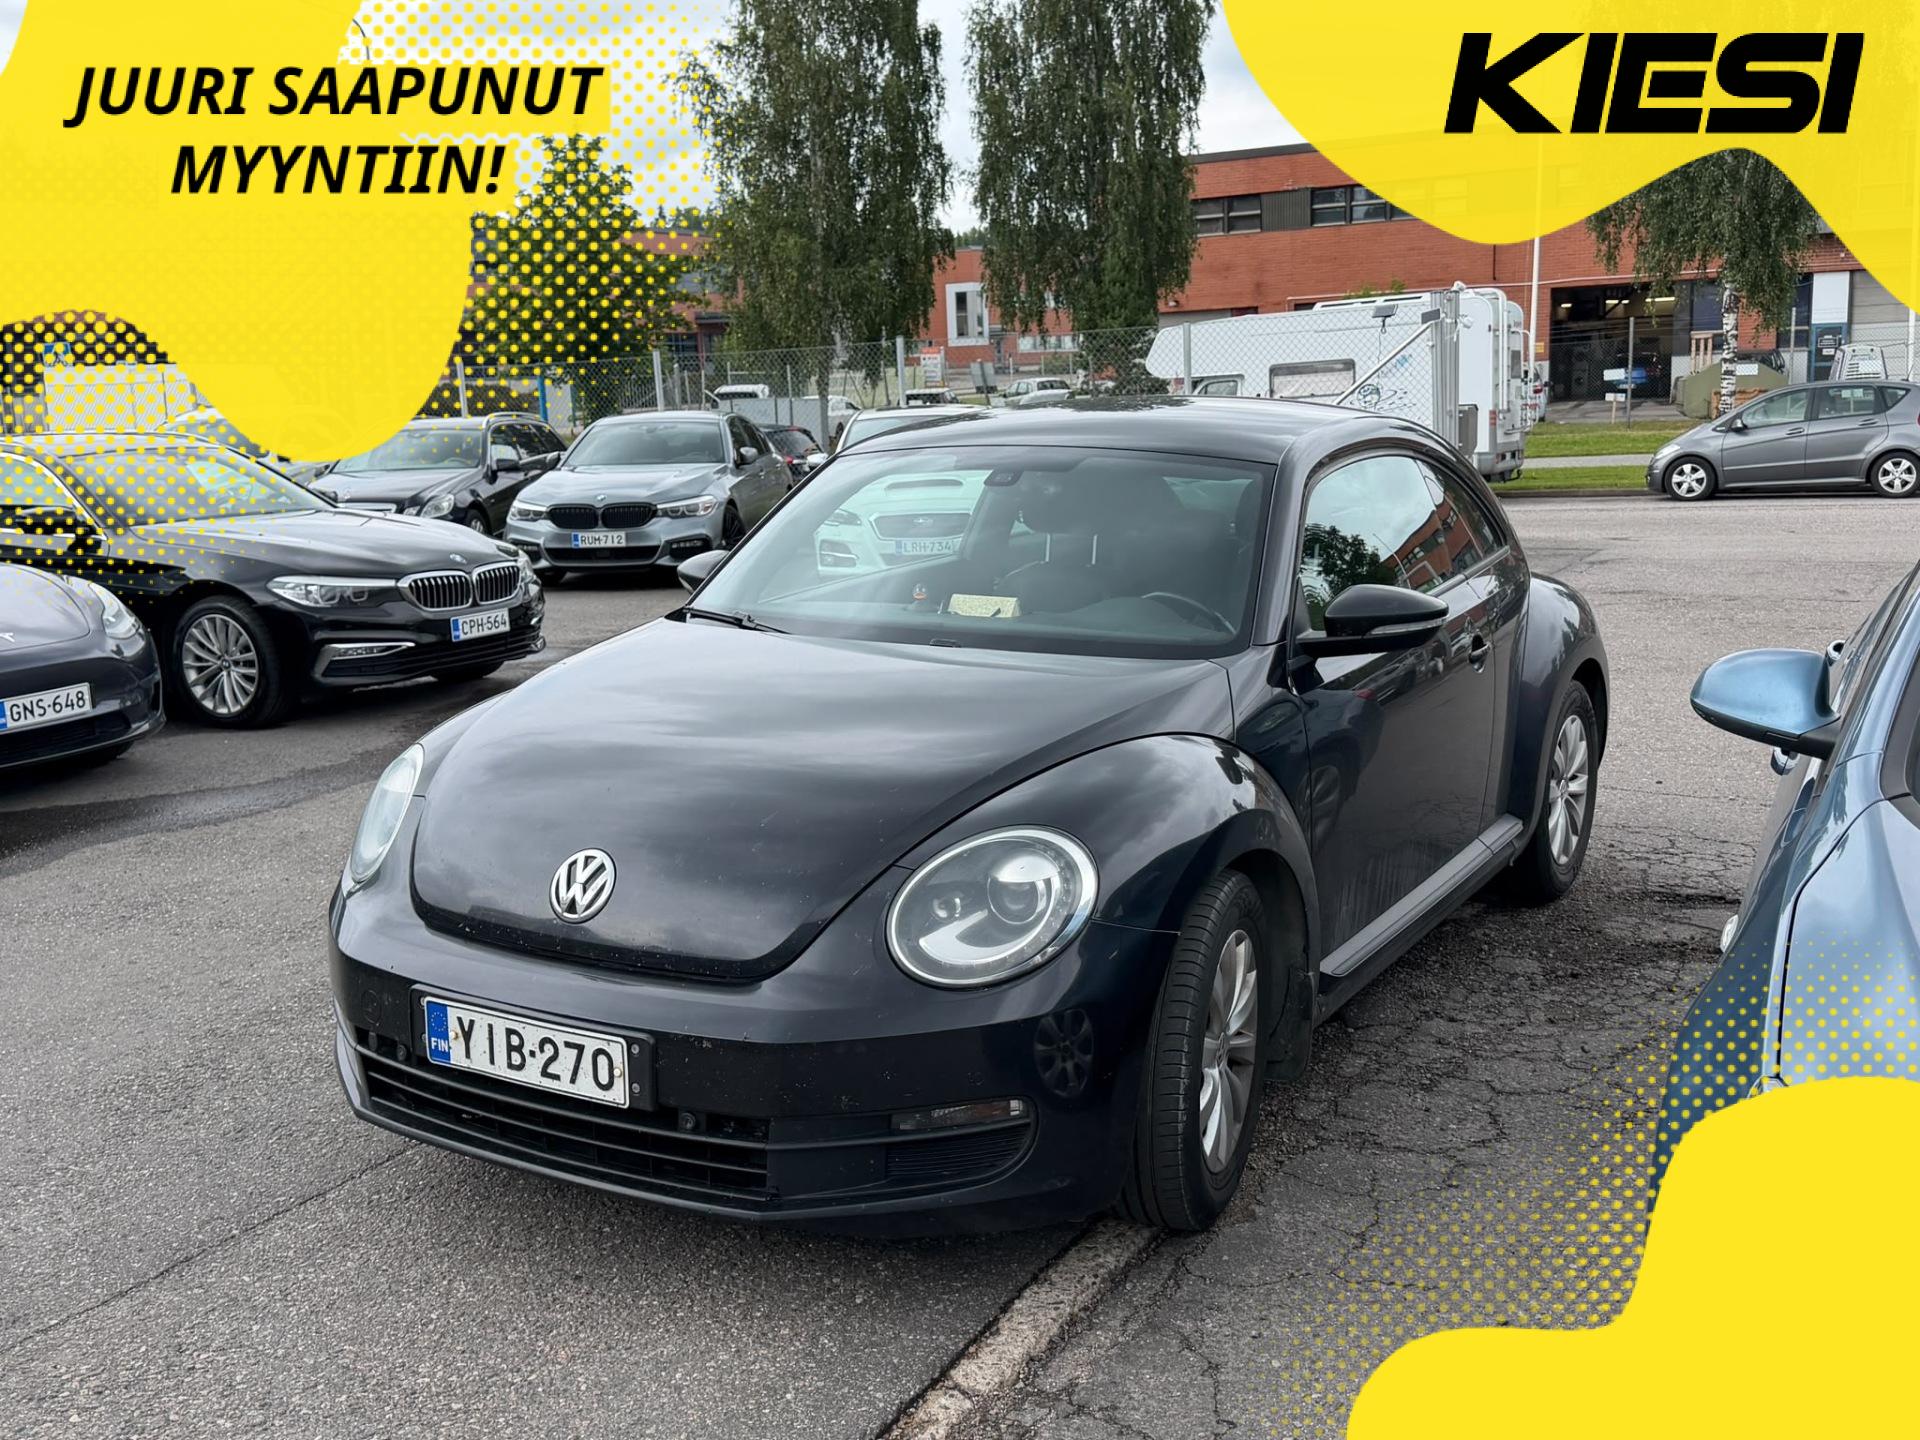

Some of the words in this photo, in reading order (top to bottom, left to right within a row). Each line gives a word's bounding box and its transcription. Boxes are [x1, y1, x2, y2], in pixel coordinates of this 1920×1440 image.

[580, 534, 623, 545] RUM-712
[461, 613, 507, 636] CPH-564
[9, 690, 86, 722] GNS-648
[430, 1037, 450, 1053] FIN
[456, 1015, 616, 1092] YIB-270
